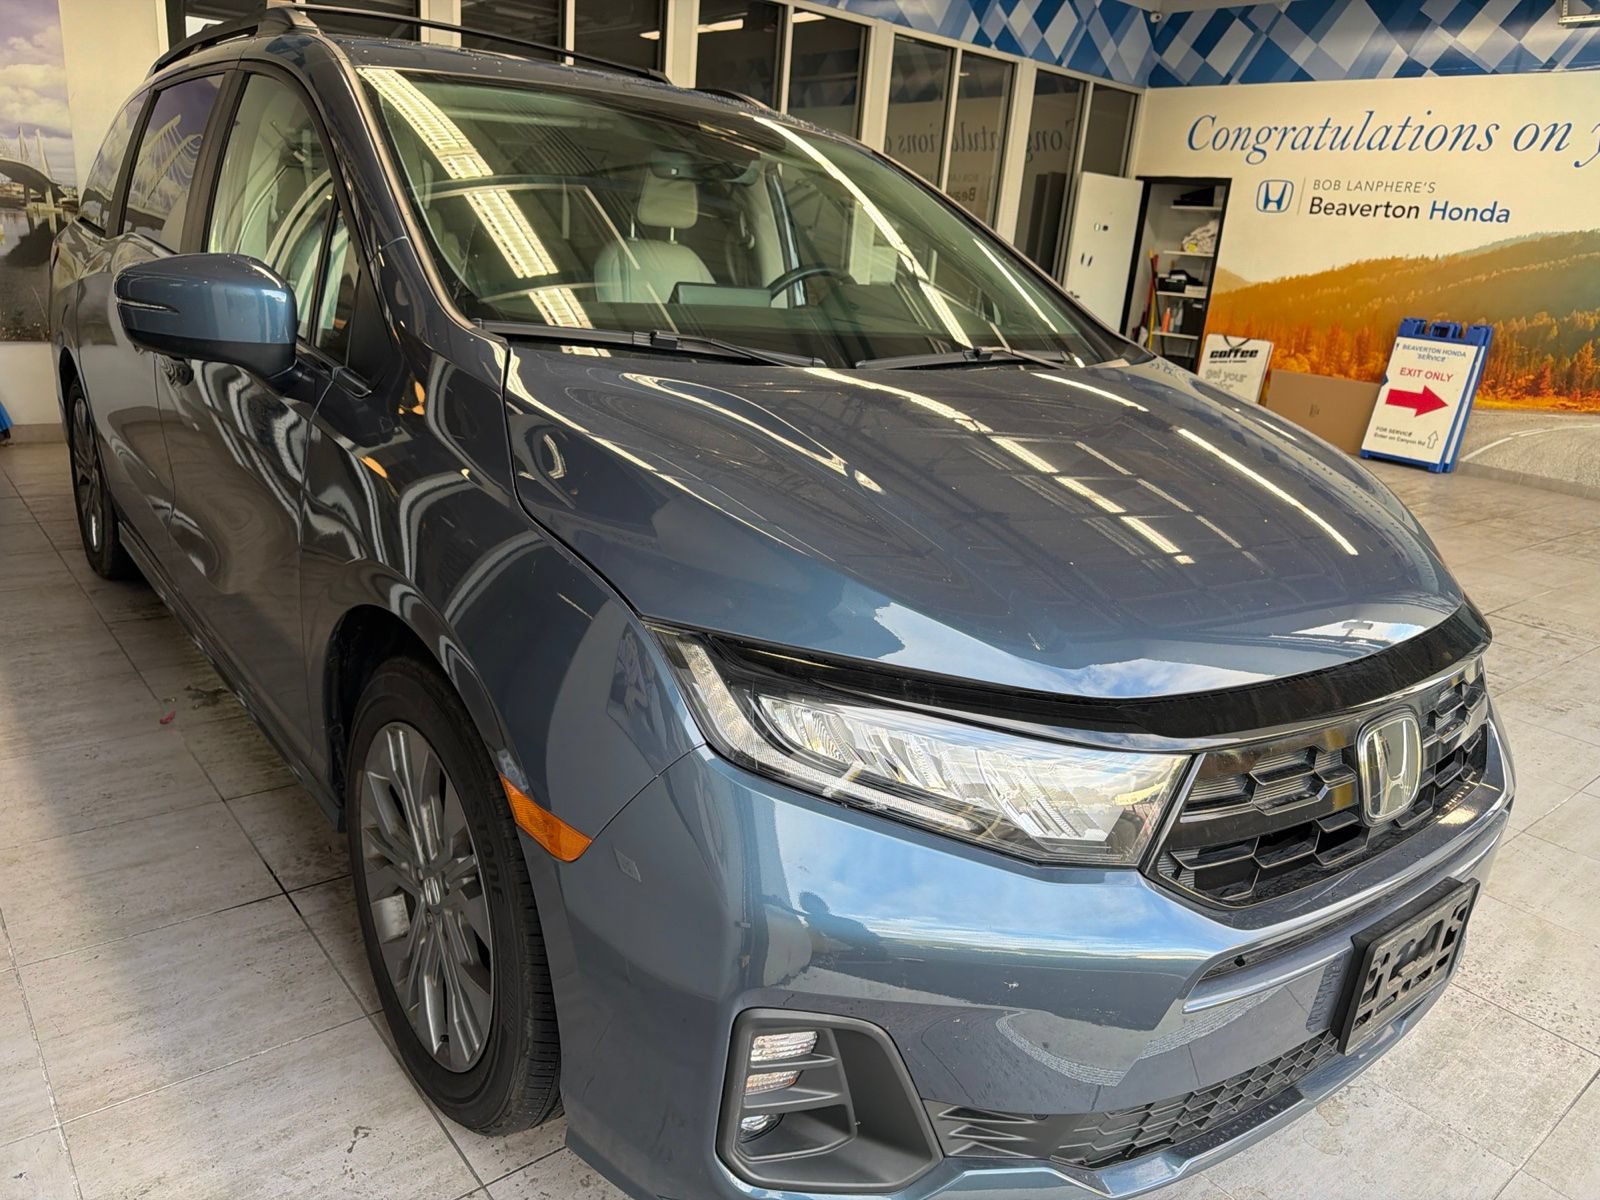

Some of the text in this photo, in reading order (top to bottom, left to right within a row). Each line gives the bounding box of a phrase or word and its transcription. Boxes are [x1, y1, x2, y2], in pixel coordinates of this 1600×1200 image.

[1187, 110, 1500, 165] Congratulations
[1513, 121, 1571, 153] on
[1313, 179, 1437, 194] BOB LANPHERE'S
[1308, 196, 1511, 224] Beaverton Honda
[1209, 347, 1259, 359] coffee
[1402, 344, 1467, 358] BEAVERTON HONDA
[1417, 354, 1446, 362] SERVICE
[1399, 367, 1454, 382] EXIT ONLY
